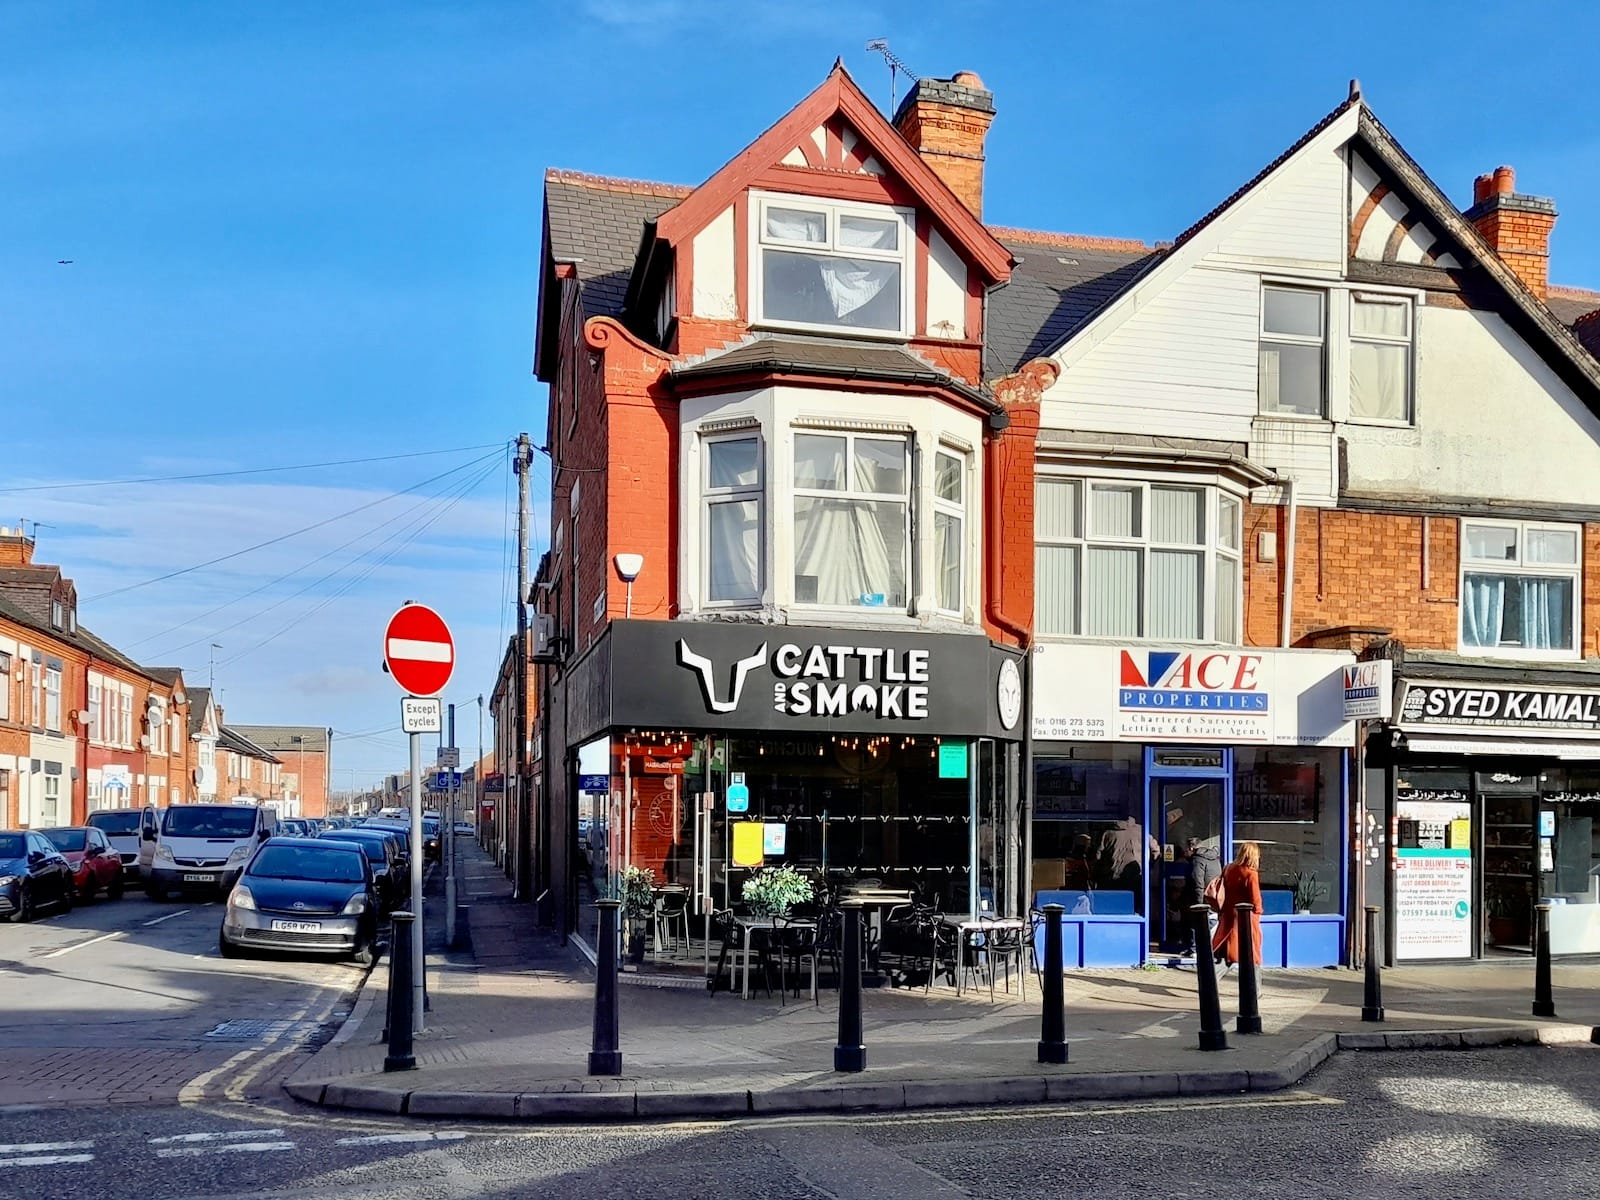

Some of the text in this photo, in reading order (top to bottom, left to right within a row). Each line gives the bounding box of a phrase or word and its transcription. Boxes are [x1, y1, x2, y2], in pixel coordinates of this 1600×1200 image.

[775, 643, 930, 682] CATTLE
[1163, 652, 1263, 691] ACE
[1354, 664, 1378, 688] ACE
[774, 682, 787, 713] AND
[790, 681, 930, 718] SMOKE
[1123, 692, 1265, 709] PROPERTIES
[1345, 687, 1379, 700] PROPERTIES
[406, 703, 437, 715] Except
[1425, 688, 1501, 718] SYED
[408, 718, 436, 728] cycles
[1049, 717, 1067, 726] 0116
[1069, 718, 1083, 727] 273
[1086, 719, 1105, 727] 5373
[1131, 714, 1257, 727] Chartered Surveyors
[1051, 728, 1069, 736] 0116
[1071, 729, 1085, 737] 212
[1087, 729, 1105, 737] 7373
[1121, 724, 1267, 737] Letting & Estate Agents
